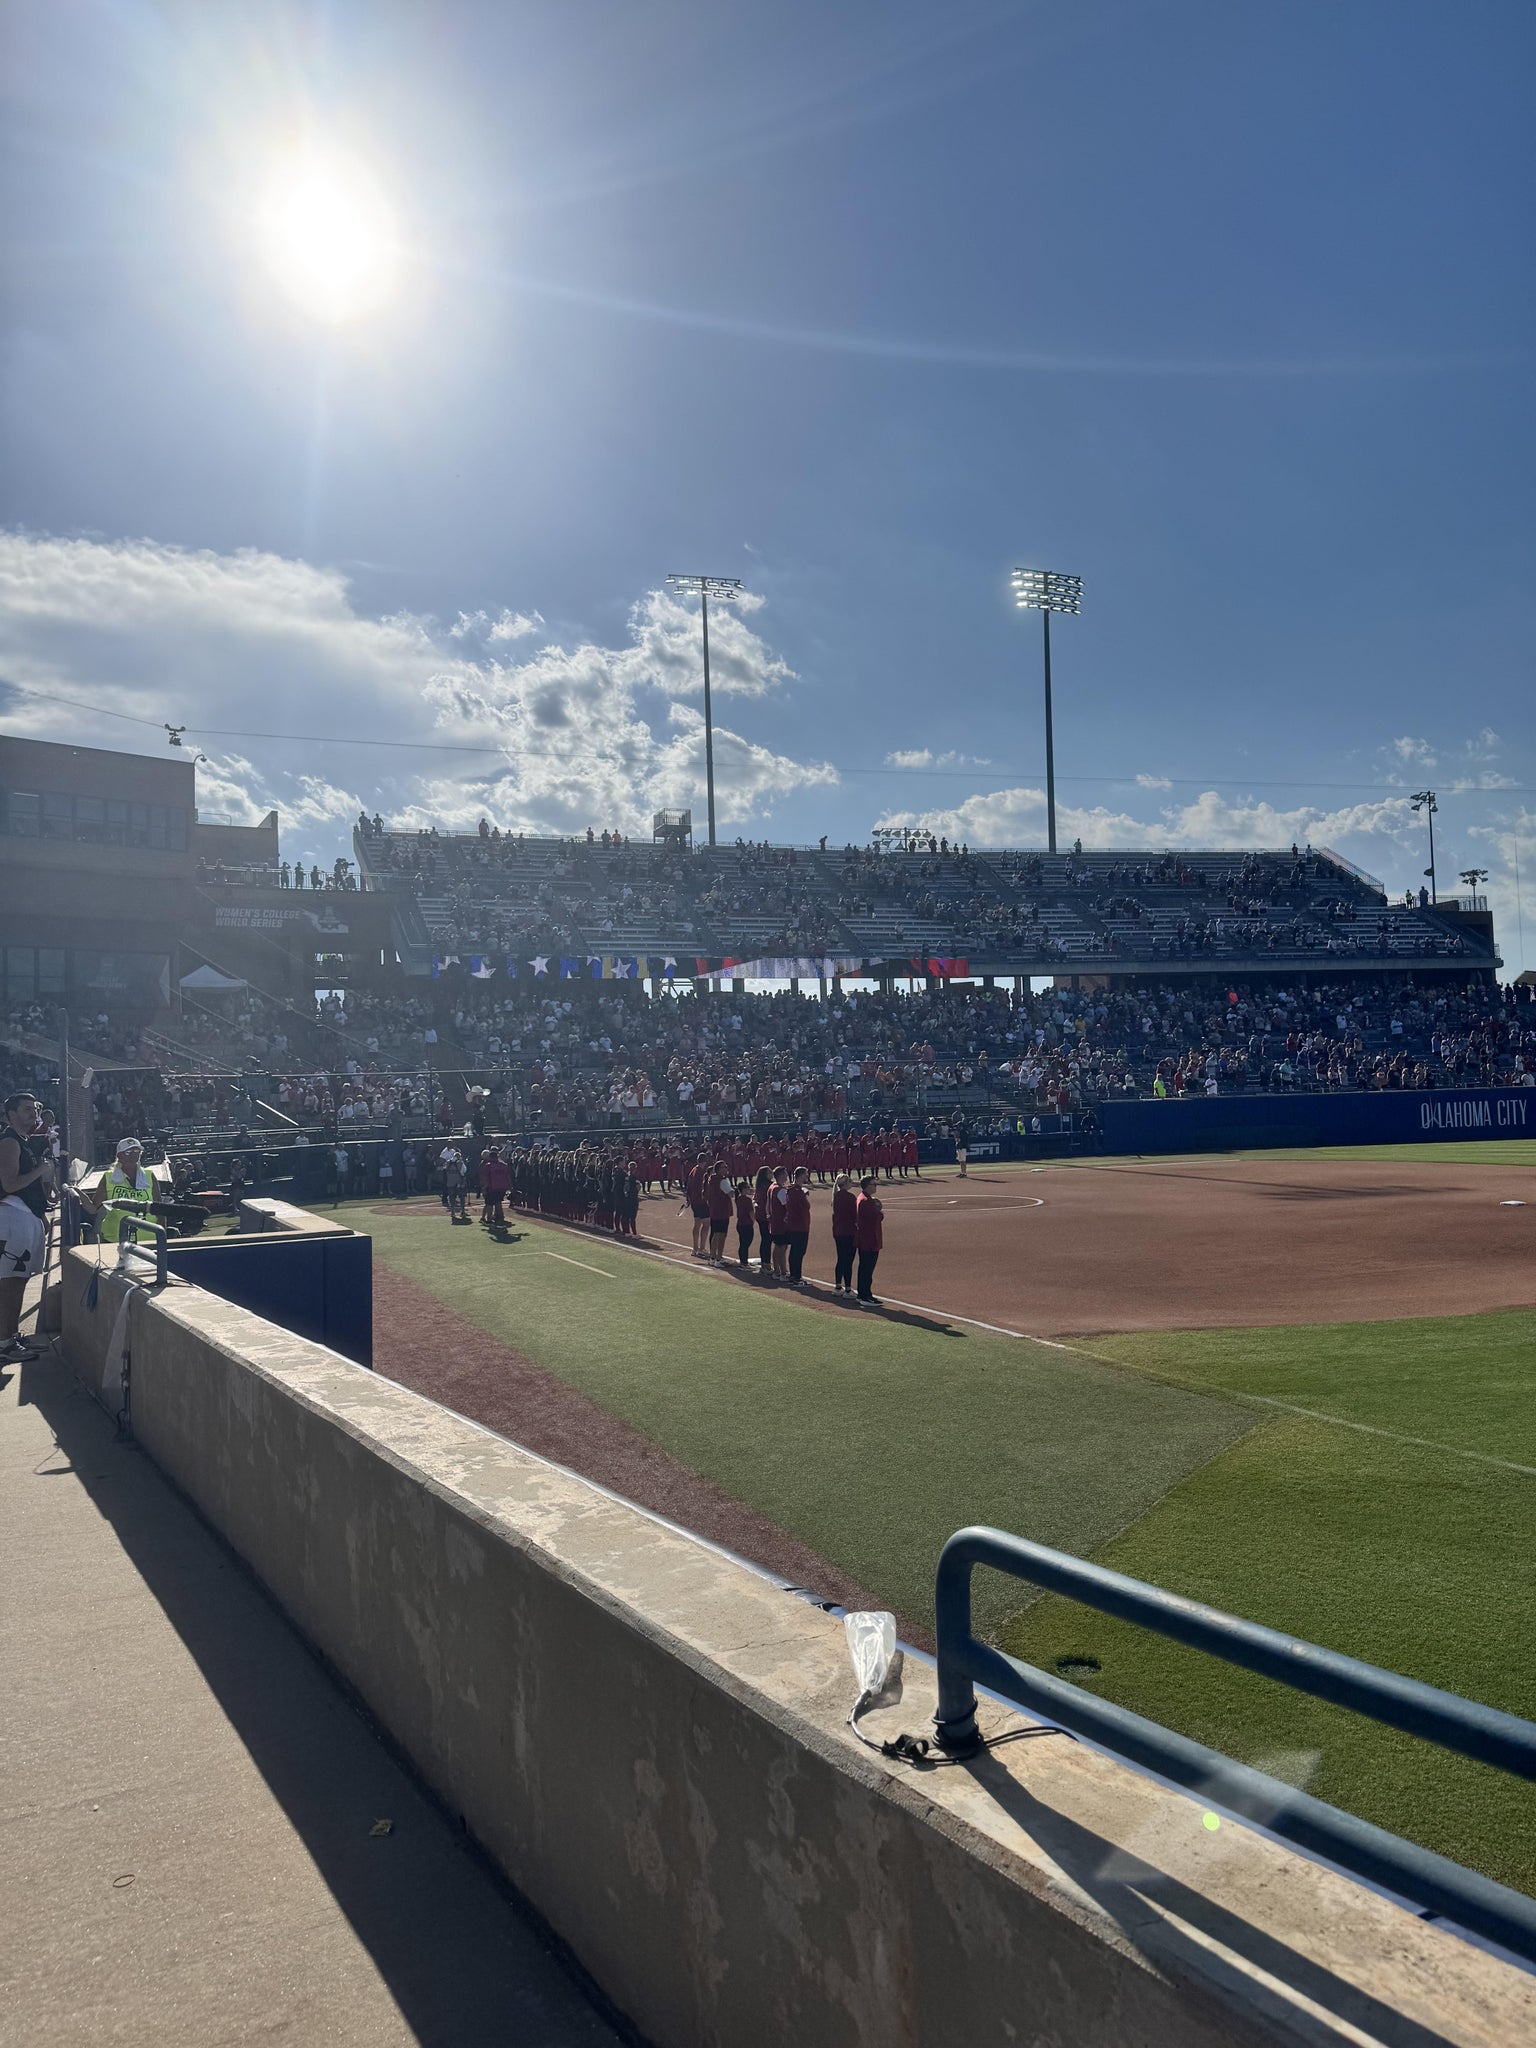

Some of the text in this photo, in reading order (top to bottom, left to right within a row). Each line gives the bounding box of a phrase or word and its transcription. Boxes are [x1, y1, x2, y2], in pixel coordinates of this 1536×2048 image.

[215, 907, 301, 920] WOMEN'S COLLEGE
[215, 917, 283, 928] WORLD SERIES
[1420, 1096, 1527, 1129] OKLAHOMA CITY
[966, 1142, 1000, 1155] SPN
